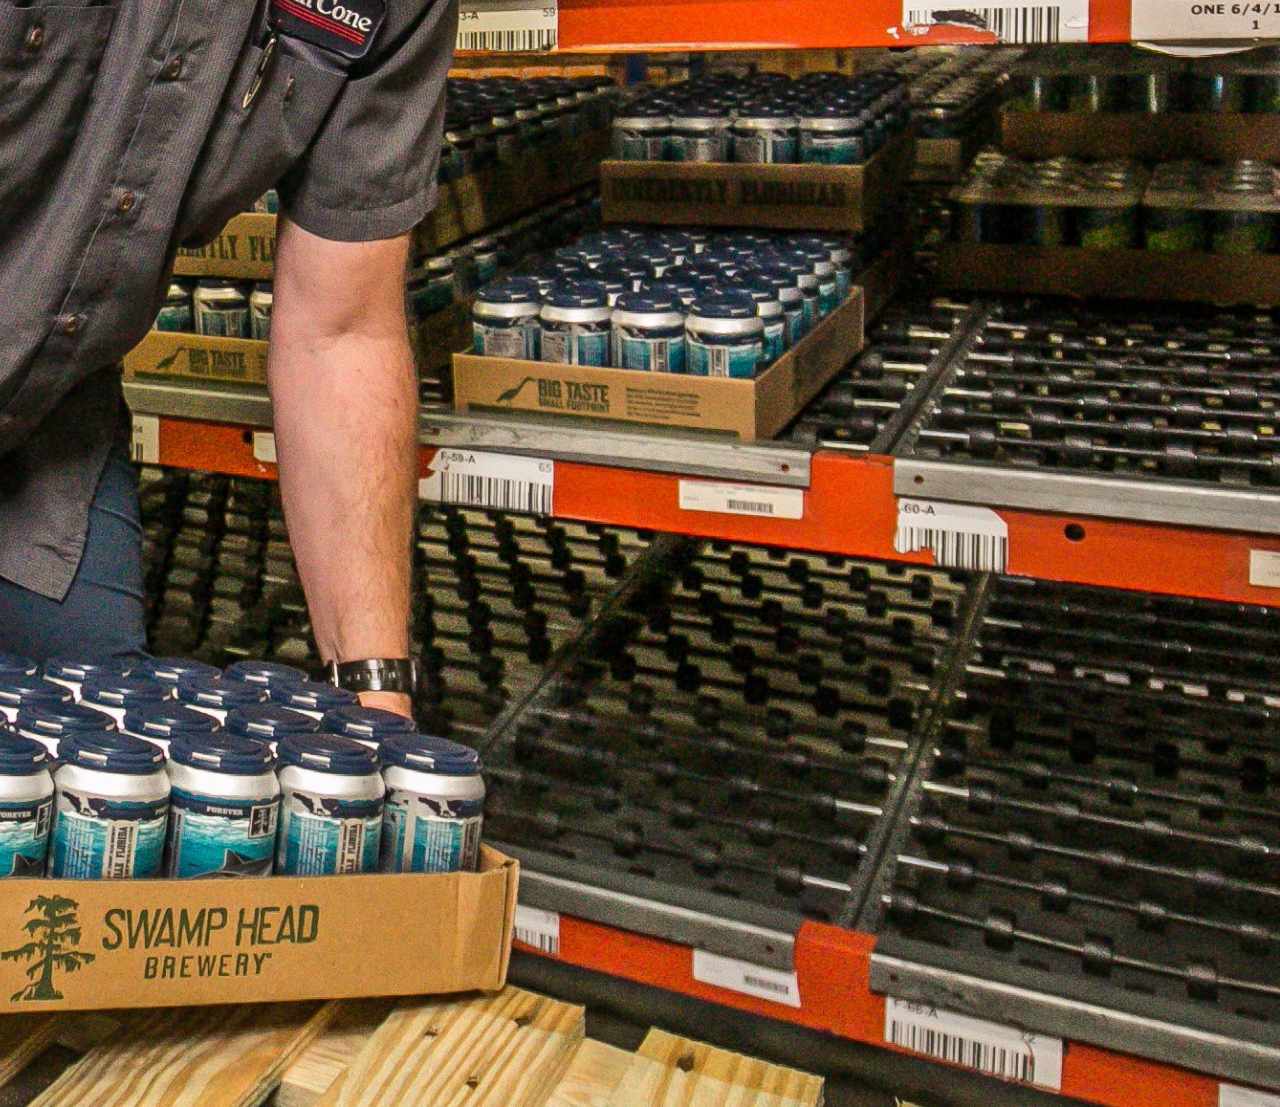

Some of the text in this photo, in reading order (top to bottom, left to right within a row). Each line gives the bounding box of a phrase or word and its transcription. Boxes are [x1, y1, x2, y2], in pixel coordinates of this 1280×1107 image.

[542, 7, 556, 18] 59
[1190, 3, 1280, 16] ONE 6/4/1
[1252, 19, 1260, 30] 1
[538, 378, 562, 399] BIG
[565, 381, 609, 403] TASTE
[440, 450, 476, 464] F-59-A
[538, 462, 552, 473] 65
[206, 805, 244, 817] FOREVER
[116, 827, 128, 858] FLORIDA
[102, 904, 320, 951] SWAMP HEAD
[143, 953, 272, 980] BREWERY
